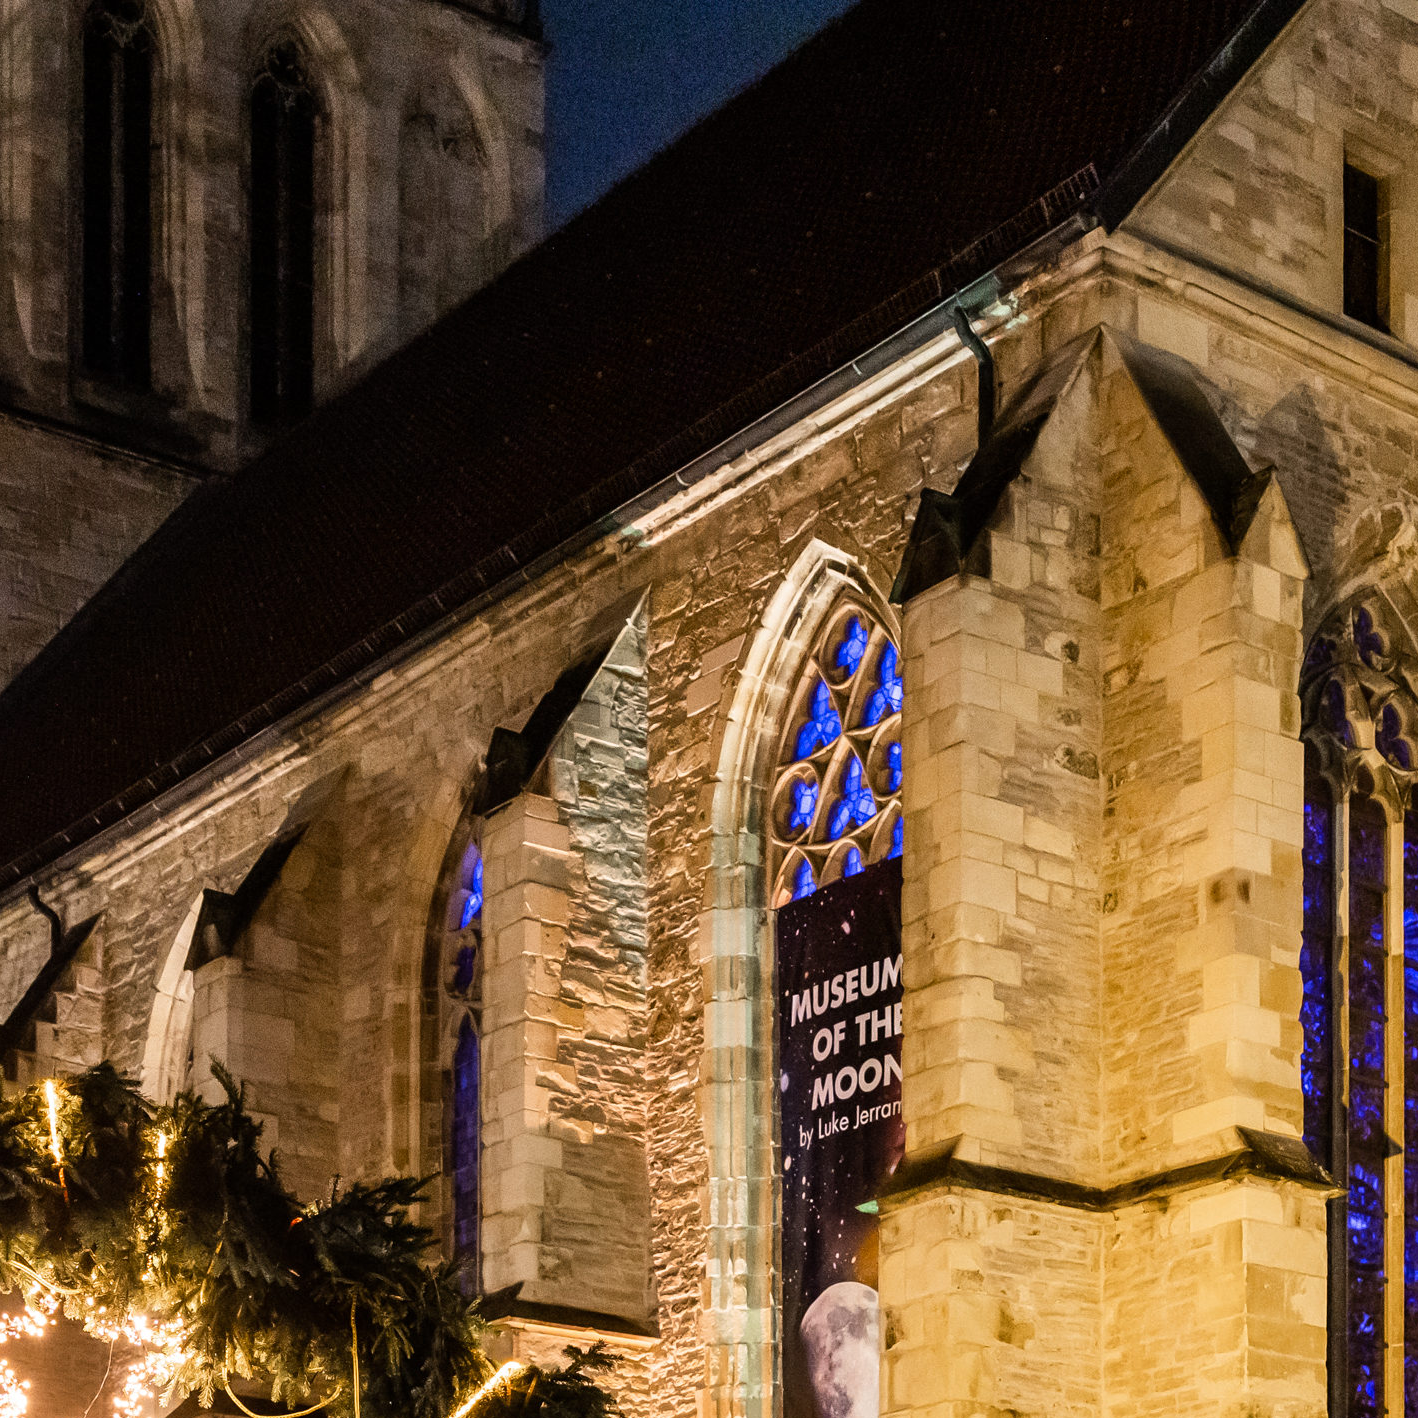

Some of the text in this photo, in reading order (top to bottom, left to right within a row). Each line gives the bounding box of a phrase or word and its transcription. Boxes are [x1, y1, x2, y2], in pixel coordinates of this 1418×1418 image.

[791, 953, 903, 1027] MUSEUM
[813, 1001, 902, 1061] OF THE
[811, 1054, 903, 1111] MOON
[799, 1125, 814, 1150] by
[818, 1111, 849, 1139] Luke
